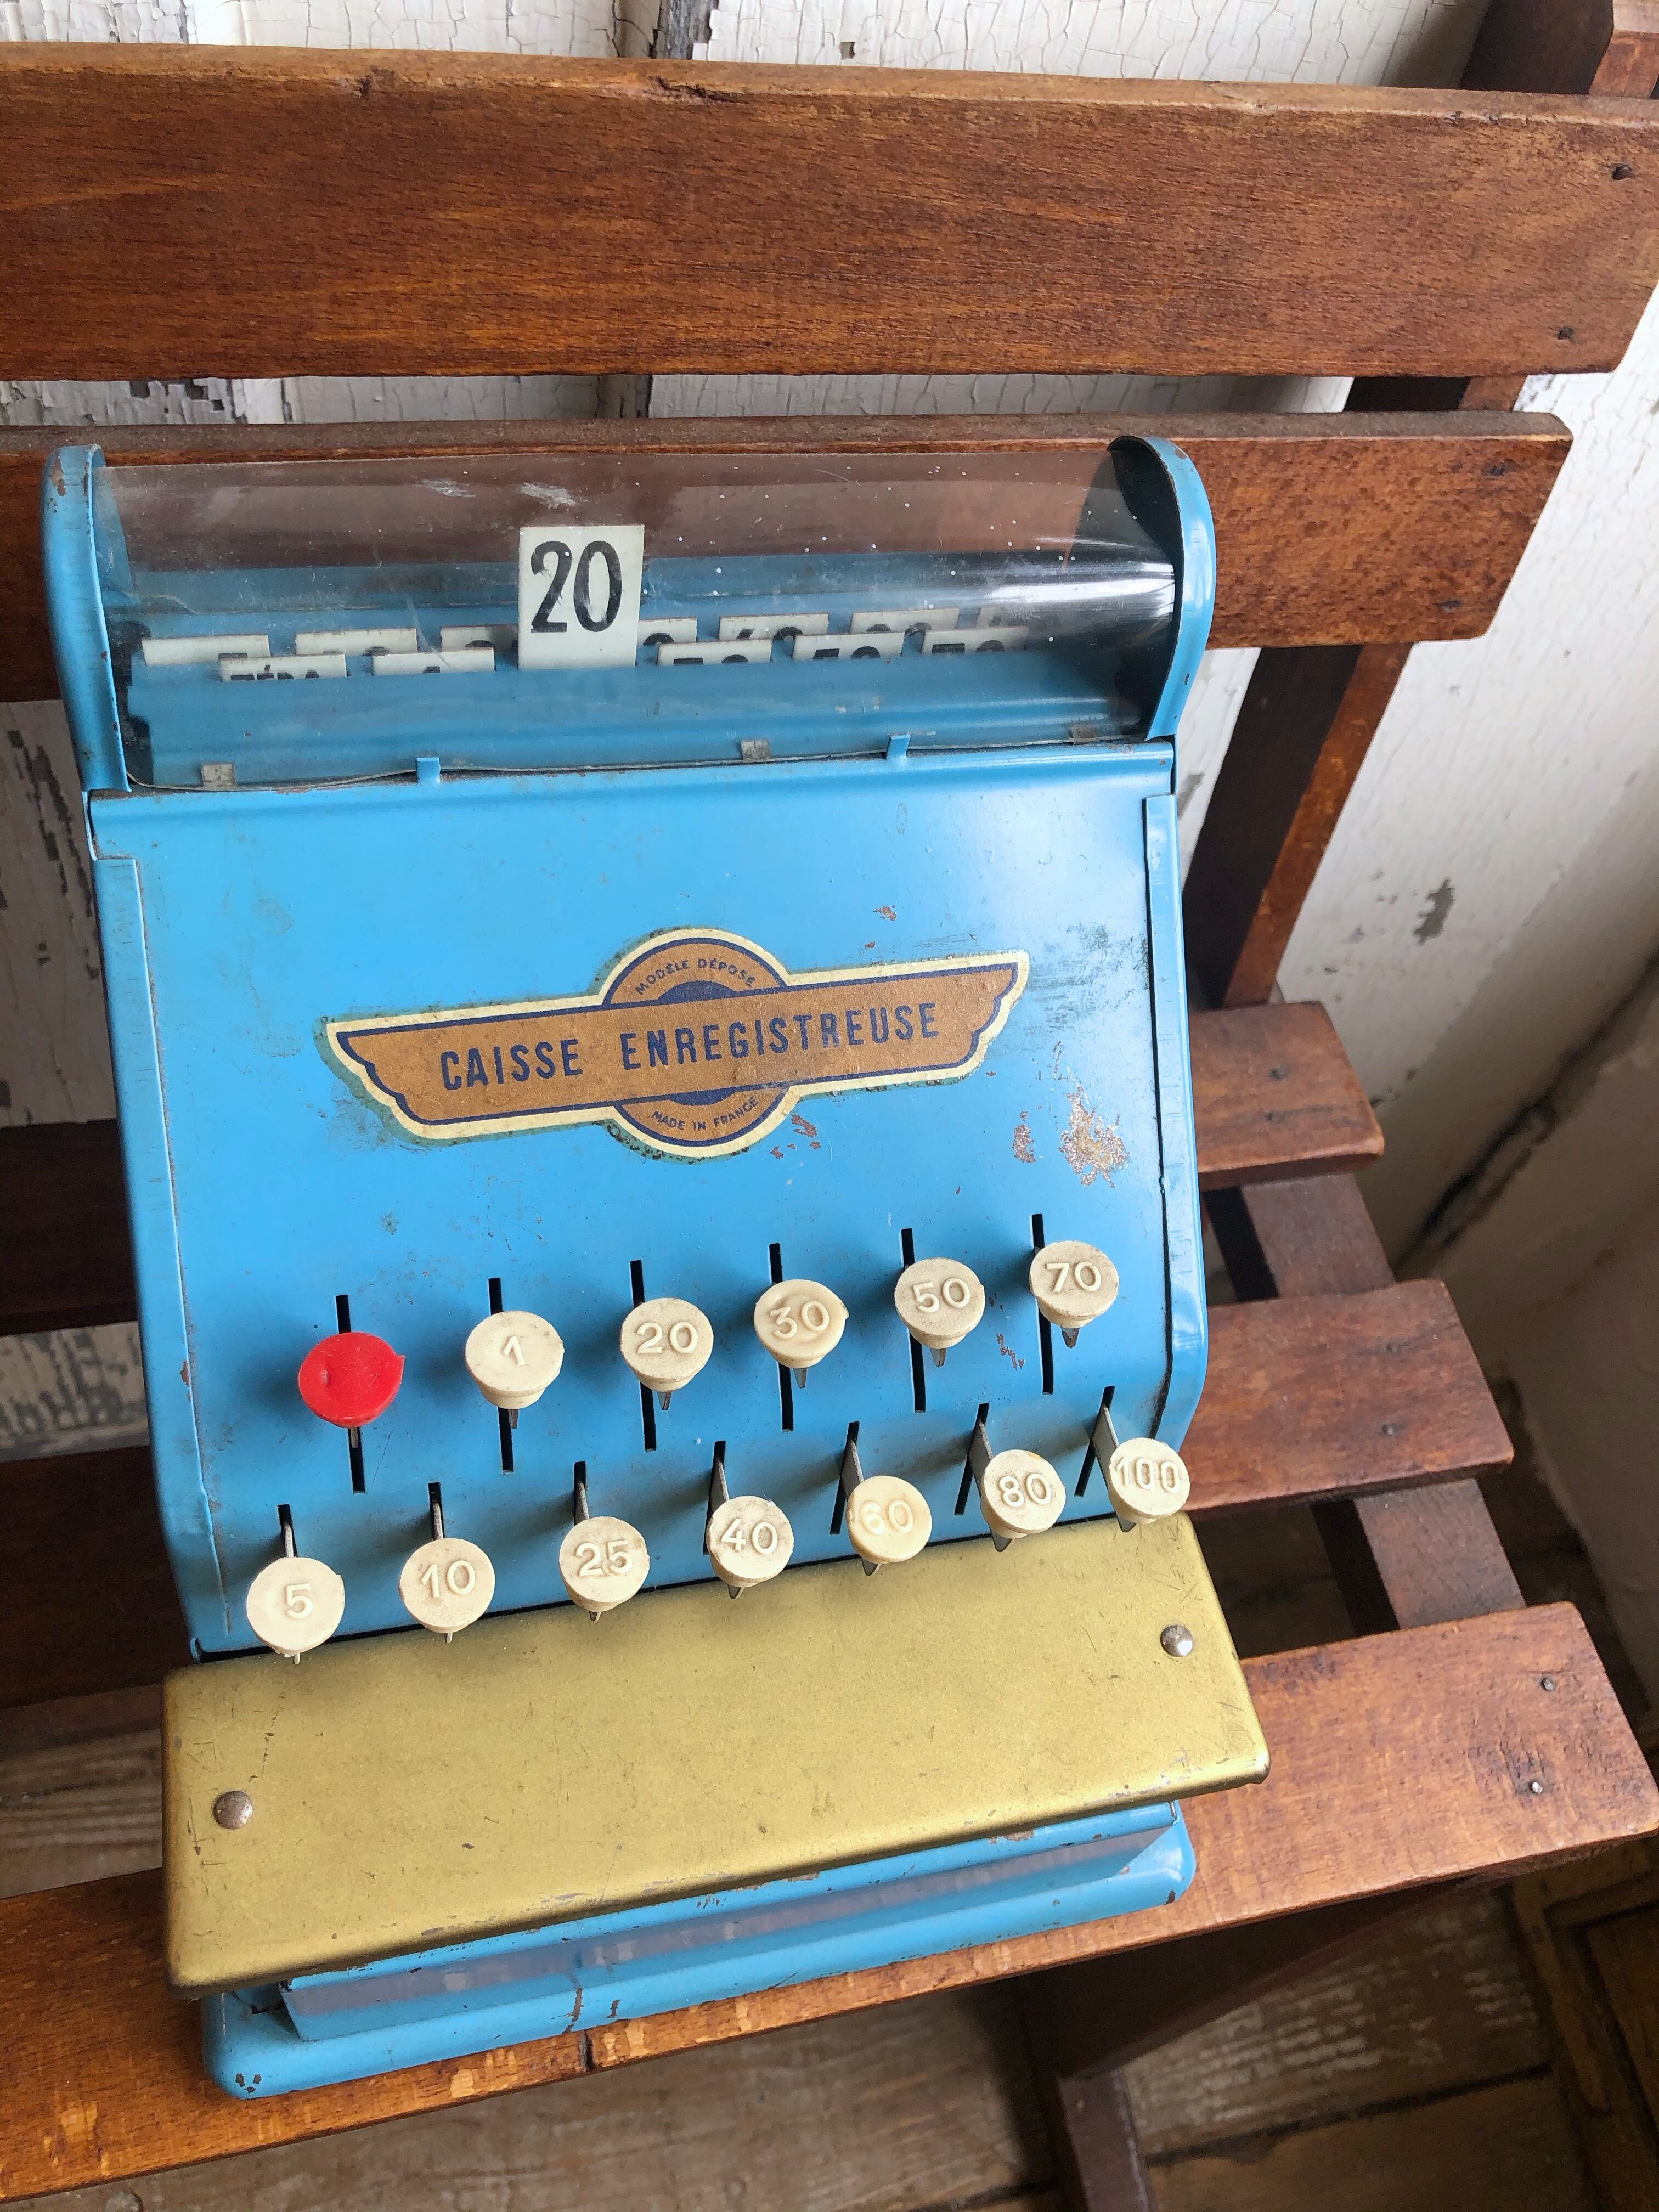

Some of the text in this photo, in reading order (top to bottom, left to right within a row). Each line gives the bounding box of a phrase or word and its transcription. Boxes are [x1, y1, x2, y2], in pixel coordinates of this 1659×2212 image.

[531, 540, 622, 634] 20
[441, 1002, 939, 1090] CAISSE ENREGISTREUSE
[651, 1097, 759, 1131] MADE IN FRANCE
[912, 1277, 971, 1313] 50
[1046, 1261, 1103, 1293] 70
[636, 1322, 699, 1355] 20
[769, 1301, 830, 1340] 30
[501, 1335, 526, 1366] 1
[997, 1474, 1052, 1508] 80
[1115, 1457, 1181, 1494] 100
[861, 1500, 914, 1536] 60
[721, 1519, 778, 1555] 40
[574, 1539, 635, 1577] 25
[420, 1559, 476, 1599] 10
[284, 1583, 313, 1618] 5
